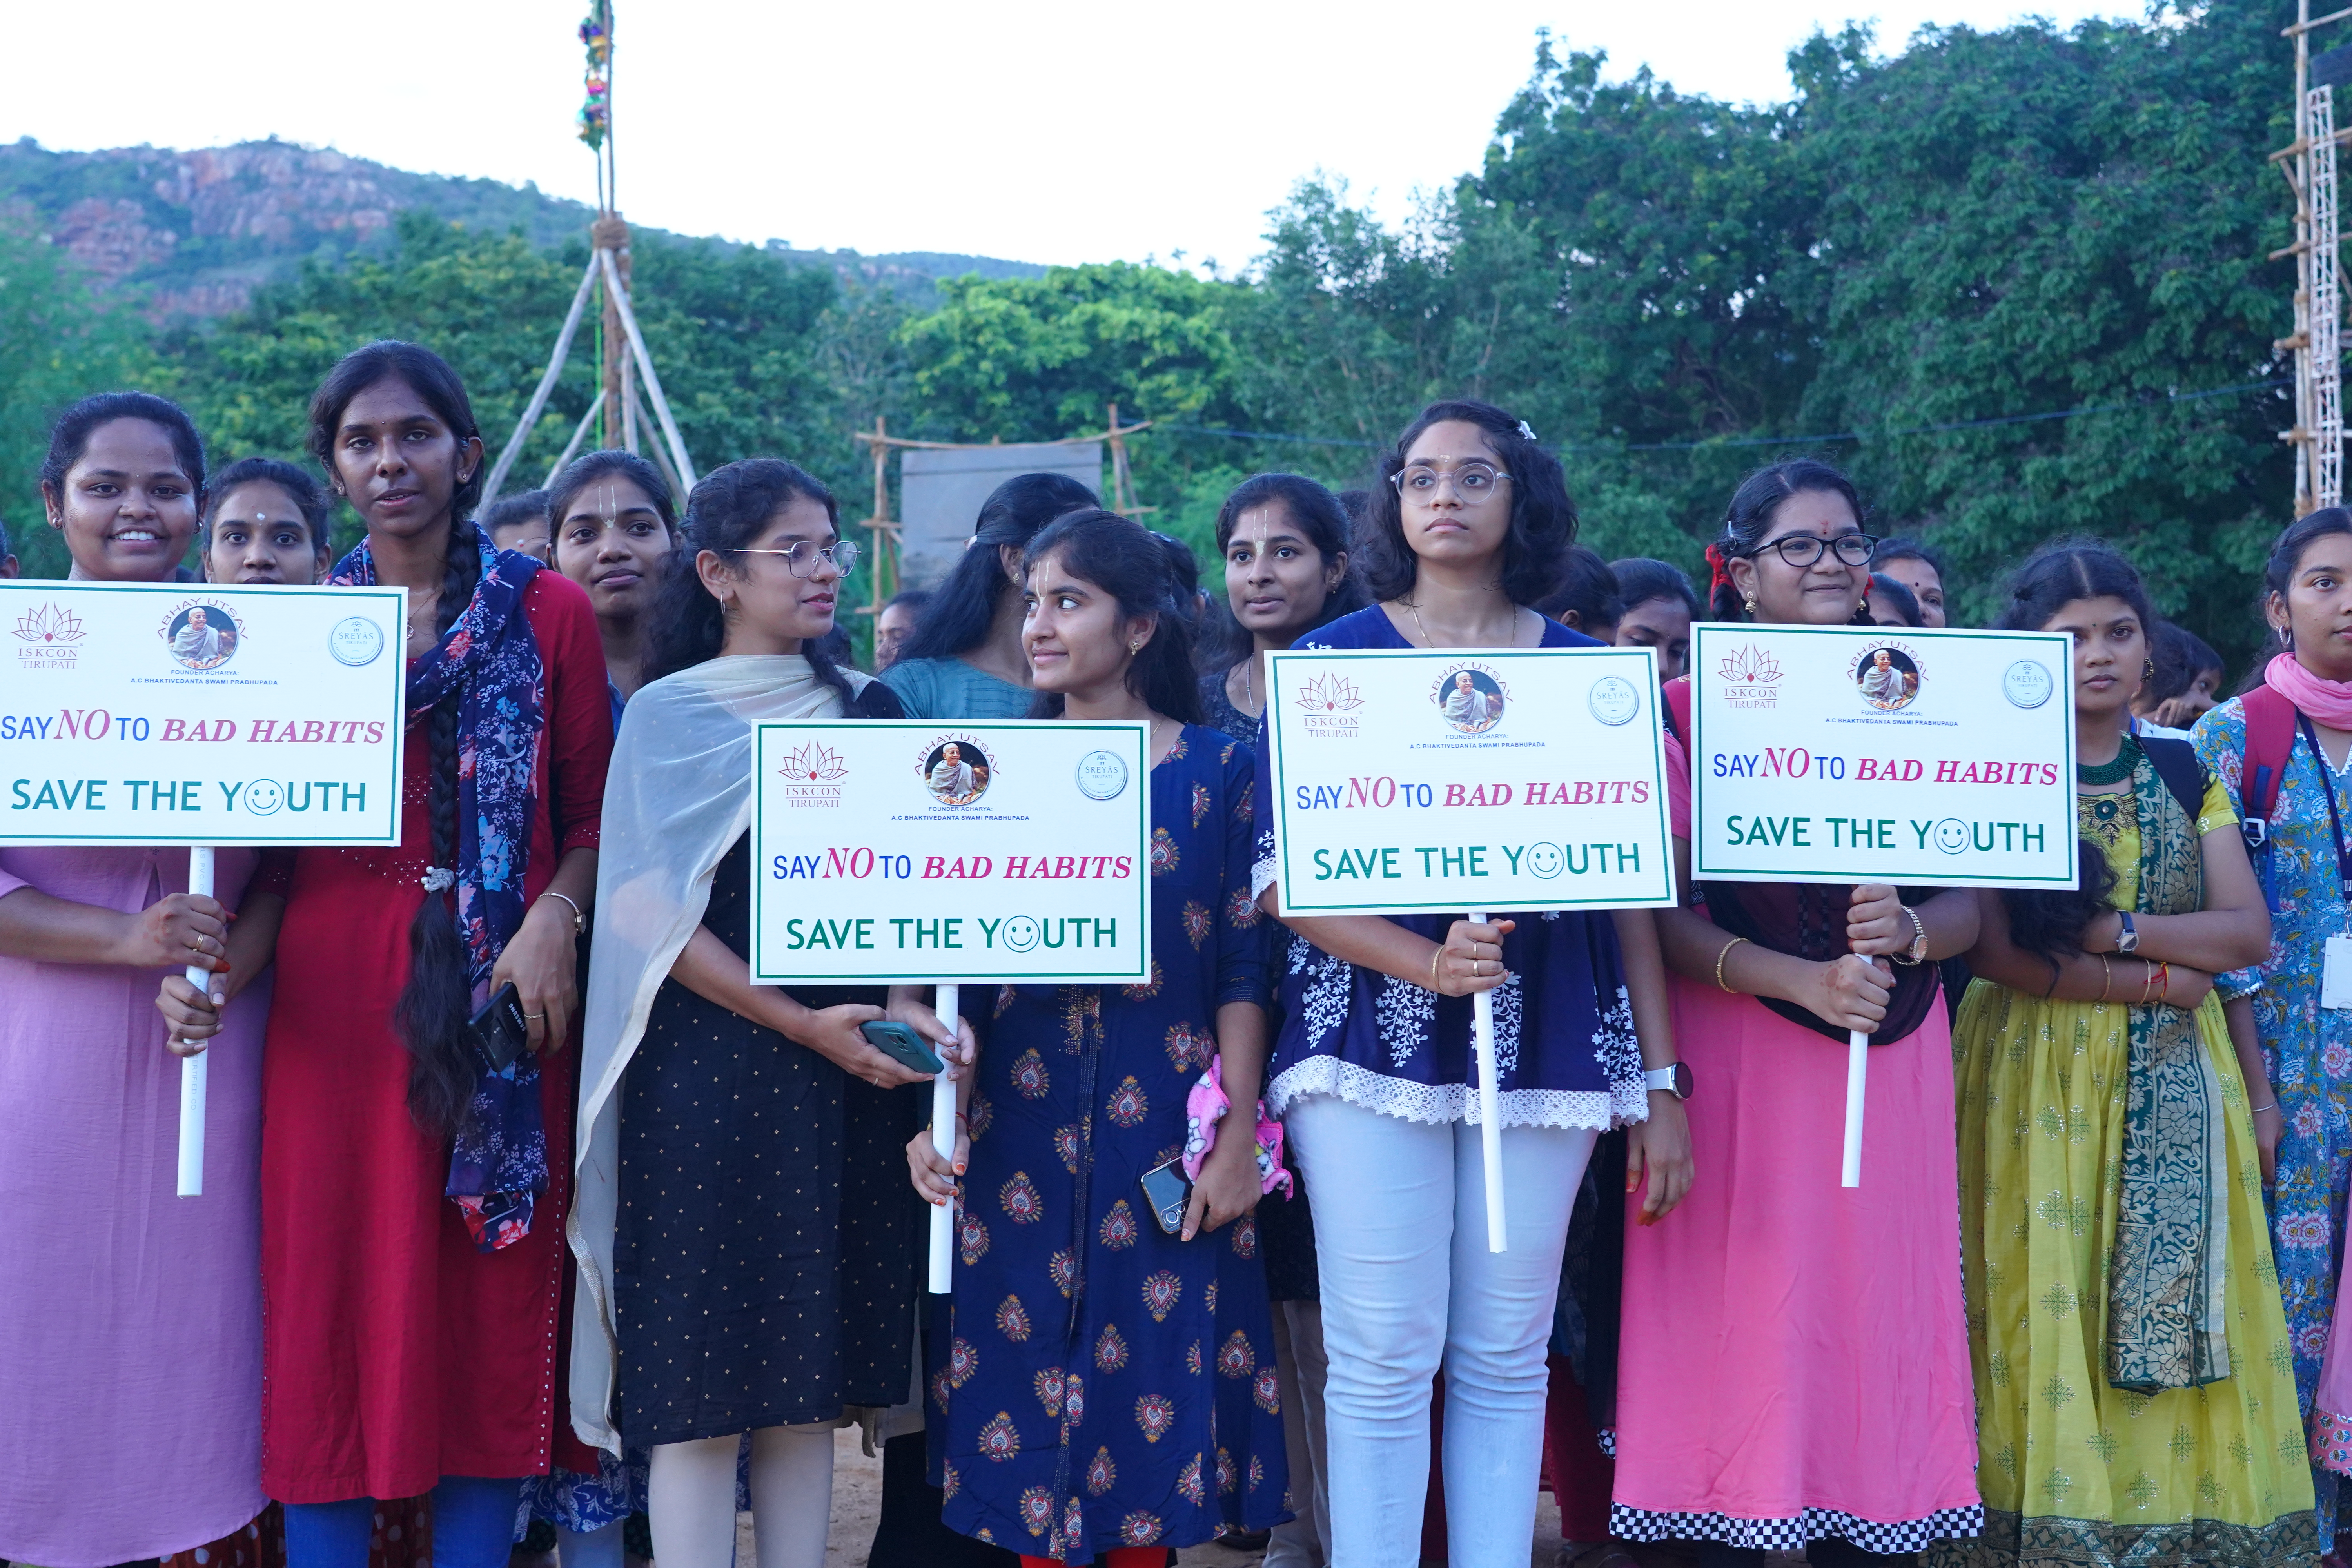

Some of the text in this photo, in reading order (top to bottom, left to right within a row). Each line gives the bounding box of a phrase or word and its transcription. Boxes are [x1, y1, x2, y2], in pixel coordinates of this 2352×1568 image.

[158, 597, 248, 639] ABHAY UTSAV
[19, 648, 77, 657] ISKCON
[22, 661, 75, 669] TIRUPATI
[1847, 640, 1929, 681] ABHAY UTSAV
[1429, 662, 1513, 704] ABHAY UTSAV
[1725, 688, 1777, 697] ISKCON
[1728, 700, 1777, 708] TIRUPATI
[1, 709, 385, 744] SAY NO TO BAD HABITS
[1305, 717, 1357, 726] ISKCON
[915, 733, 1000, 775] ABHAY UTSAV
[1714, 748, 2058, 785] SAY NO TO BAD HABITS
[11, 779, 107, 810] SAVE
[123, 781, 202, 811] THE
[1297, 777, 1649, 809] SAY NO TO BAD HABITS
[1727, 815, 1811, 846] SAVE
[1825, 818, 1896, 848] THE
[774, 848, 1132, 879] SAY NO TO BAD HABITS
[1314, 848, 1401, 880] SAVE
[1415, 846, 1488, 877] THE
[787, 919, 874, 949] SAVE
[889, 919, 962, 948] THE
[509, 1003, 526, 1031] SAMSUNG
